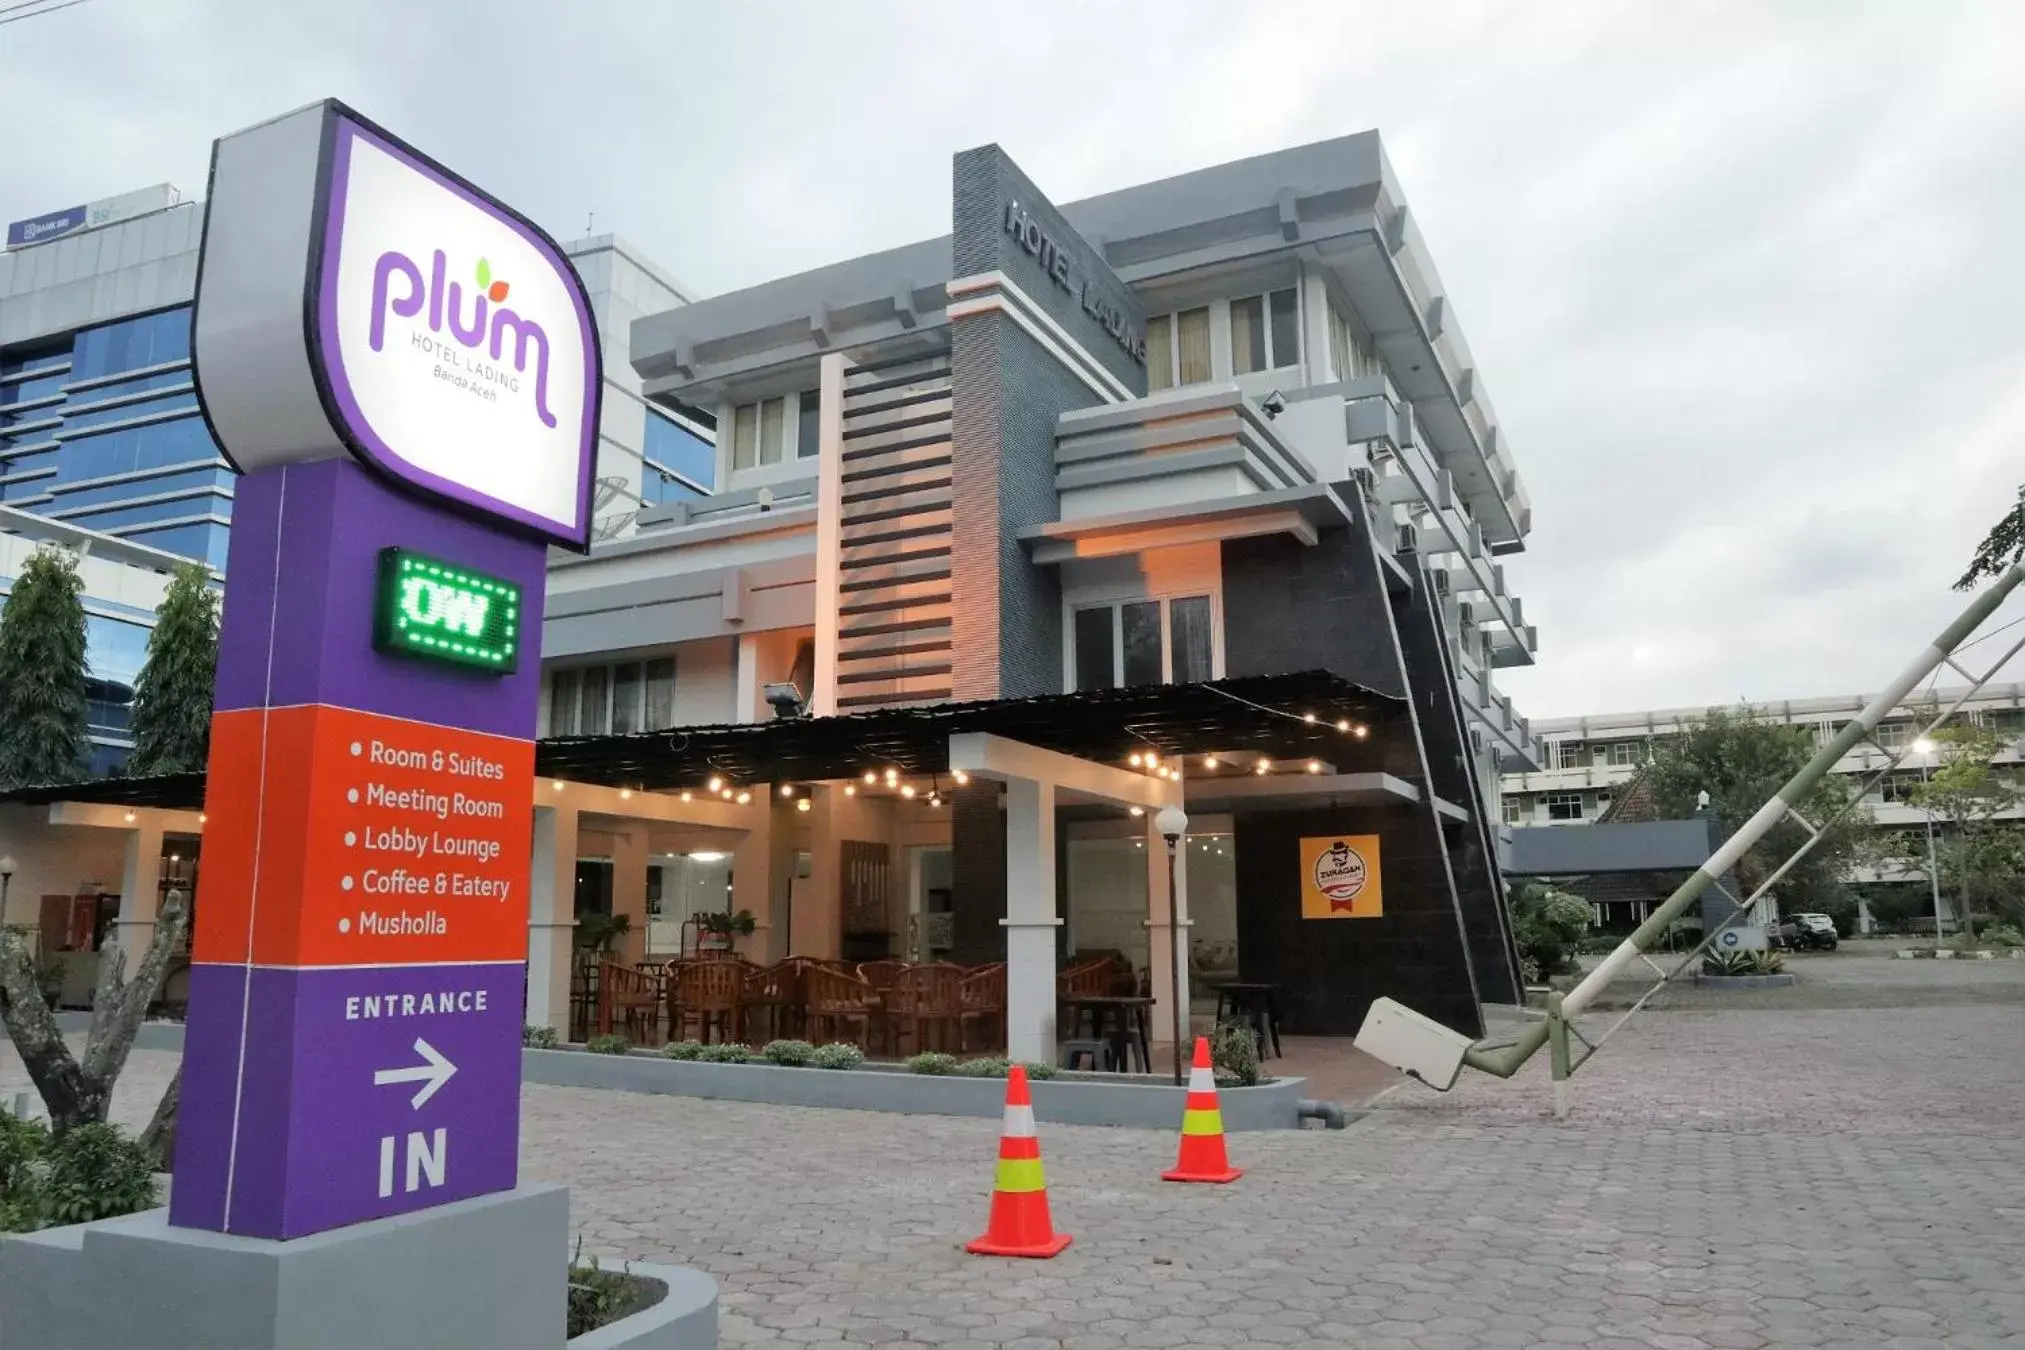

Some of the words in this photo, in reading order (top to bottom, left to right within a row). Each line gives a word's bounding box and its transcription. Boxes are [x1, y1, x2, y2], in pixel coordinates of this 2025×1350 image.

[1004, 199, 1079, 298] HOTEL
[369, 248, 556, 428] plum
[411, 330, 460, 367] HOTEL
[466, 356, 519, 393] LADING
[432, 364, 468, 389] Banda
[469, 384, 497, 402] Aceh
[370, 740, 427, 770] Room
[431, 750, 444, 771] &
[448, 753, 504, 780] Suites
[366, 783, 448, 819] Meeting
[453, 793, 503, 818] Room
[364, 826, 428, 858] Lobby
[433, 832, 500, 862] Lounge
[363, 869, 430, 894] Coffee
[434, 873, 447, 894] &
[452, 874, 510, 902] Eatery
[359, 911, 447, 935] Musholla
[345, 990, 488, 1020] ENTRANCE
[379, 1127, 447, 1198] IN
